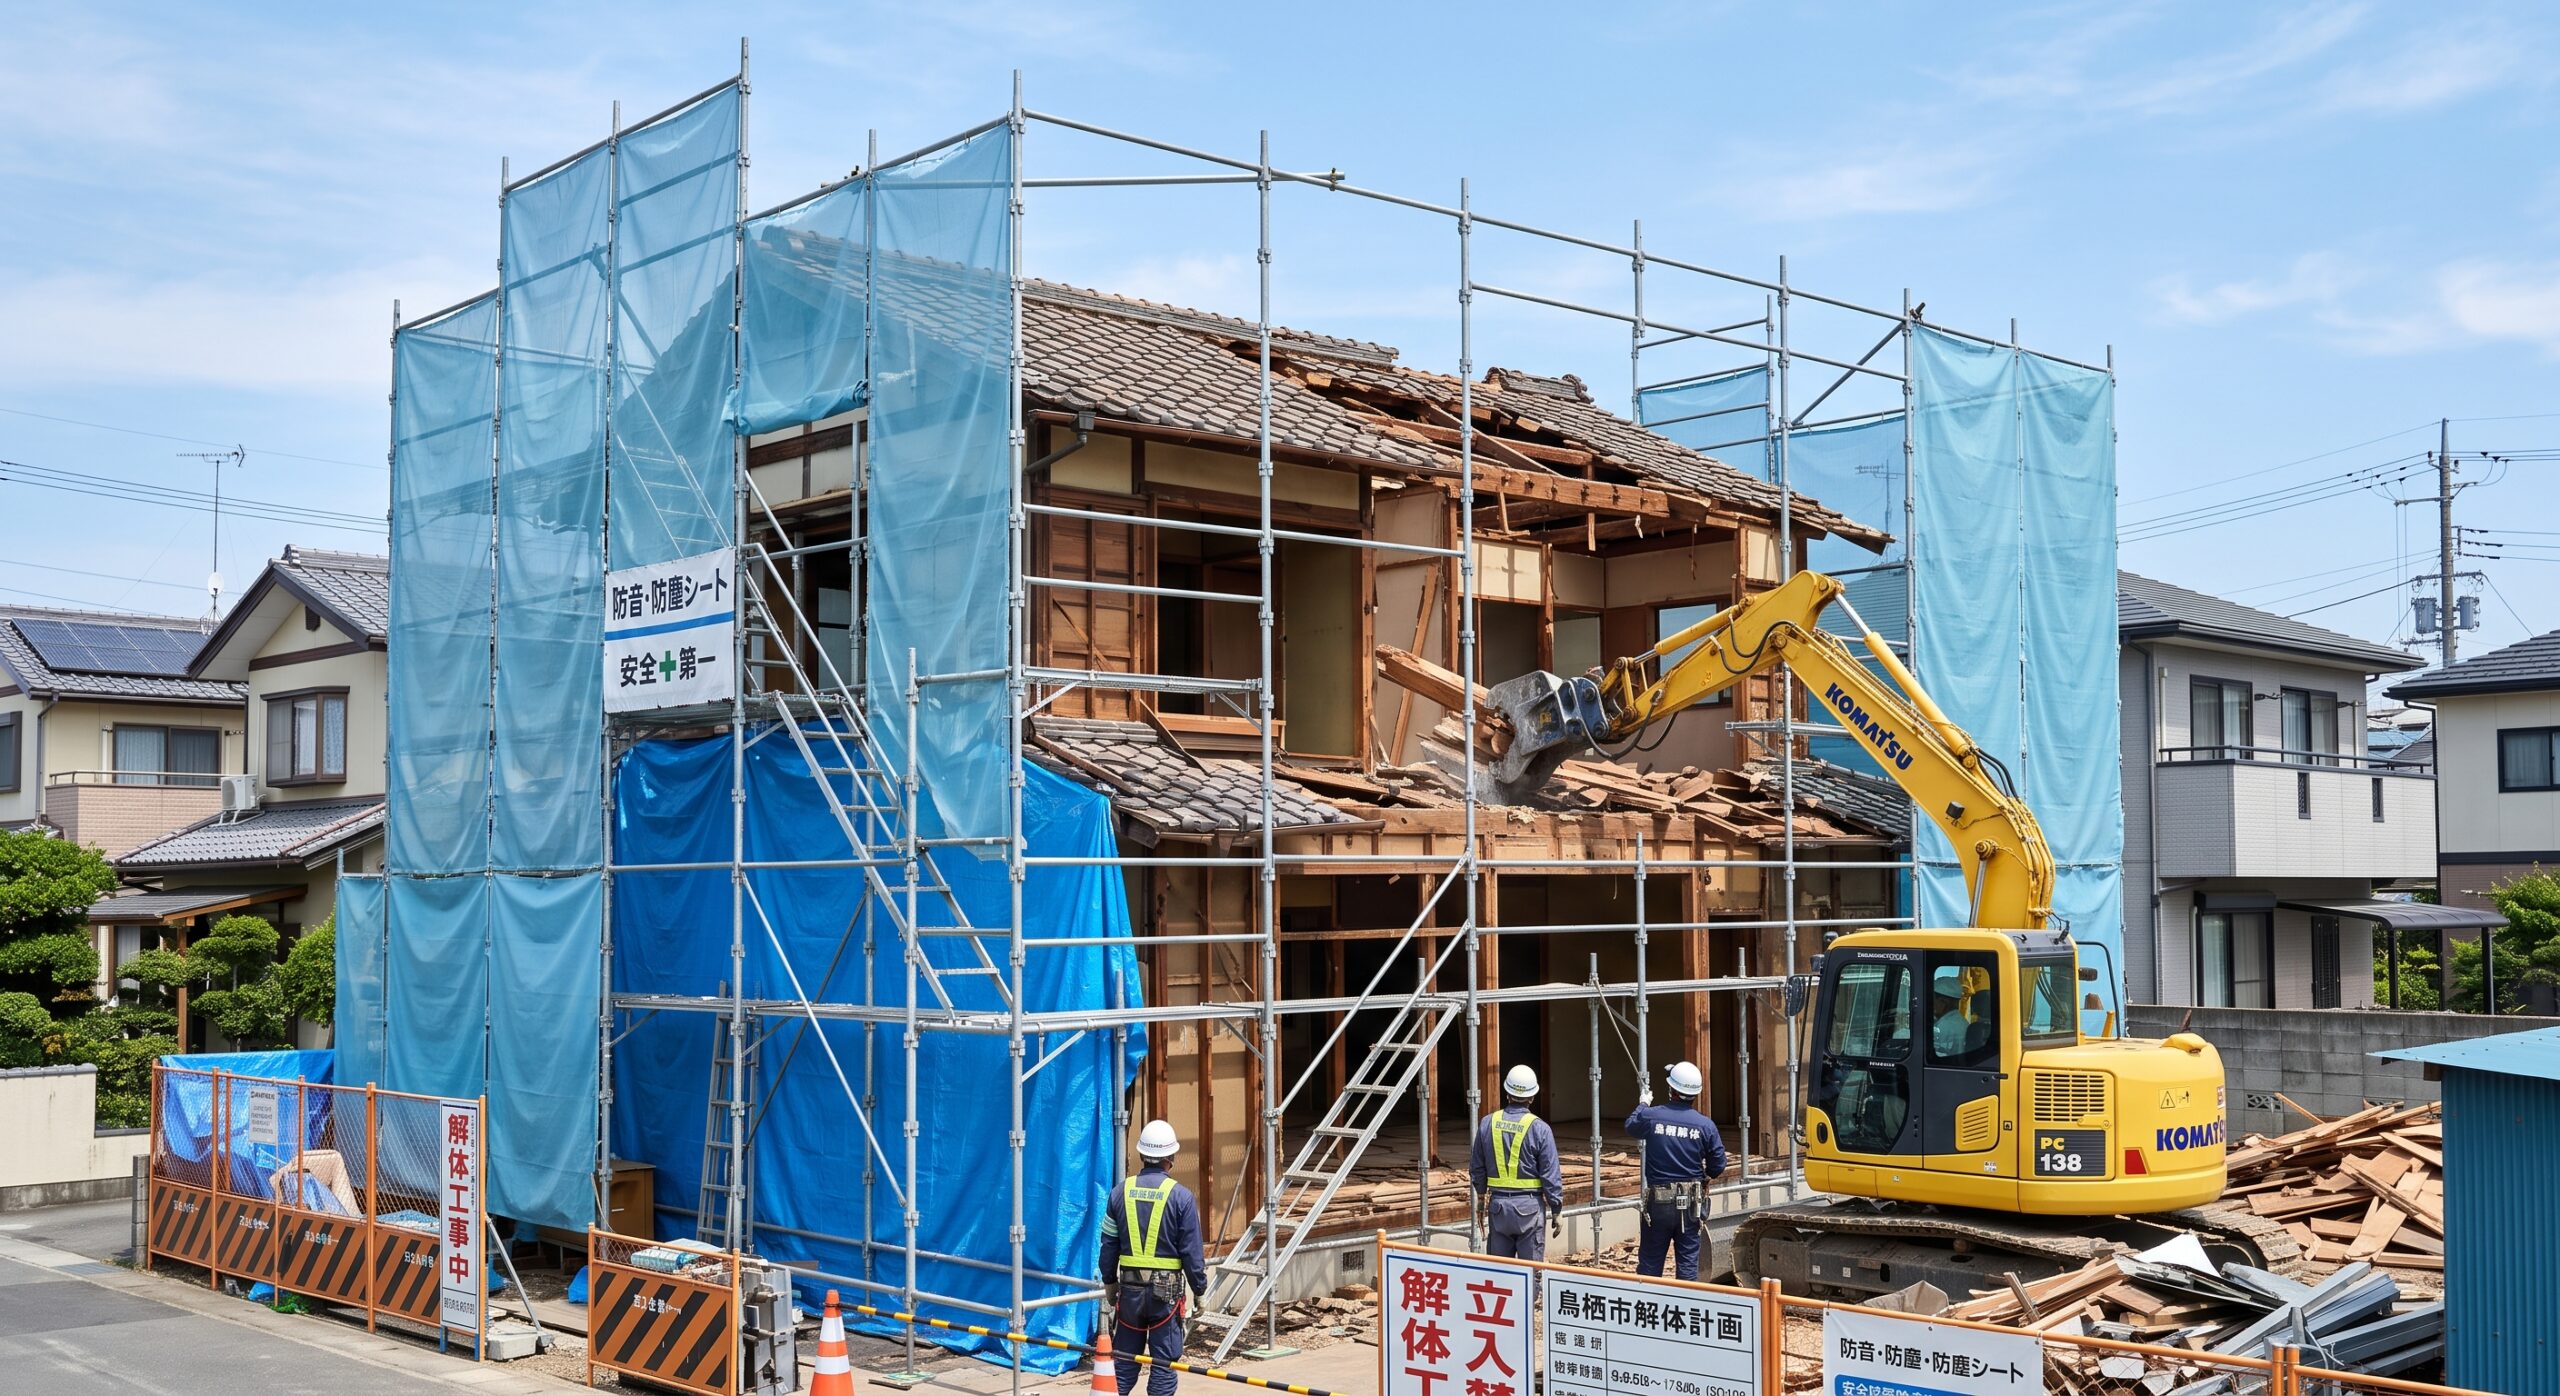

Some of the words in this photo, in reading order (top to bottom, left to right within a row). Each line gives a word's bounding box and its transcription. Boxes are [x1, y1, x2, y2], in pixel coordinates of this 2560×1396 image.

[1825, 682, 1914, 770] KOMATSU
[2041, 1136, 2065, 1151] PC
[2156, 1114, 2226, 1152] KOMATS
[2040, 1153, 2082, 1172] 138
[448, 1113, 469, 1284] 解体工事中
[1557, 1289, 1743, 1343] 鳥栖市解体計画
